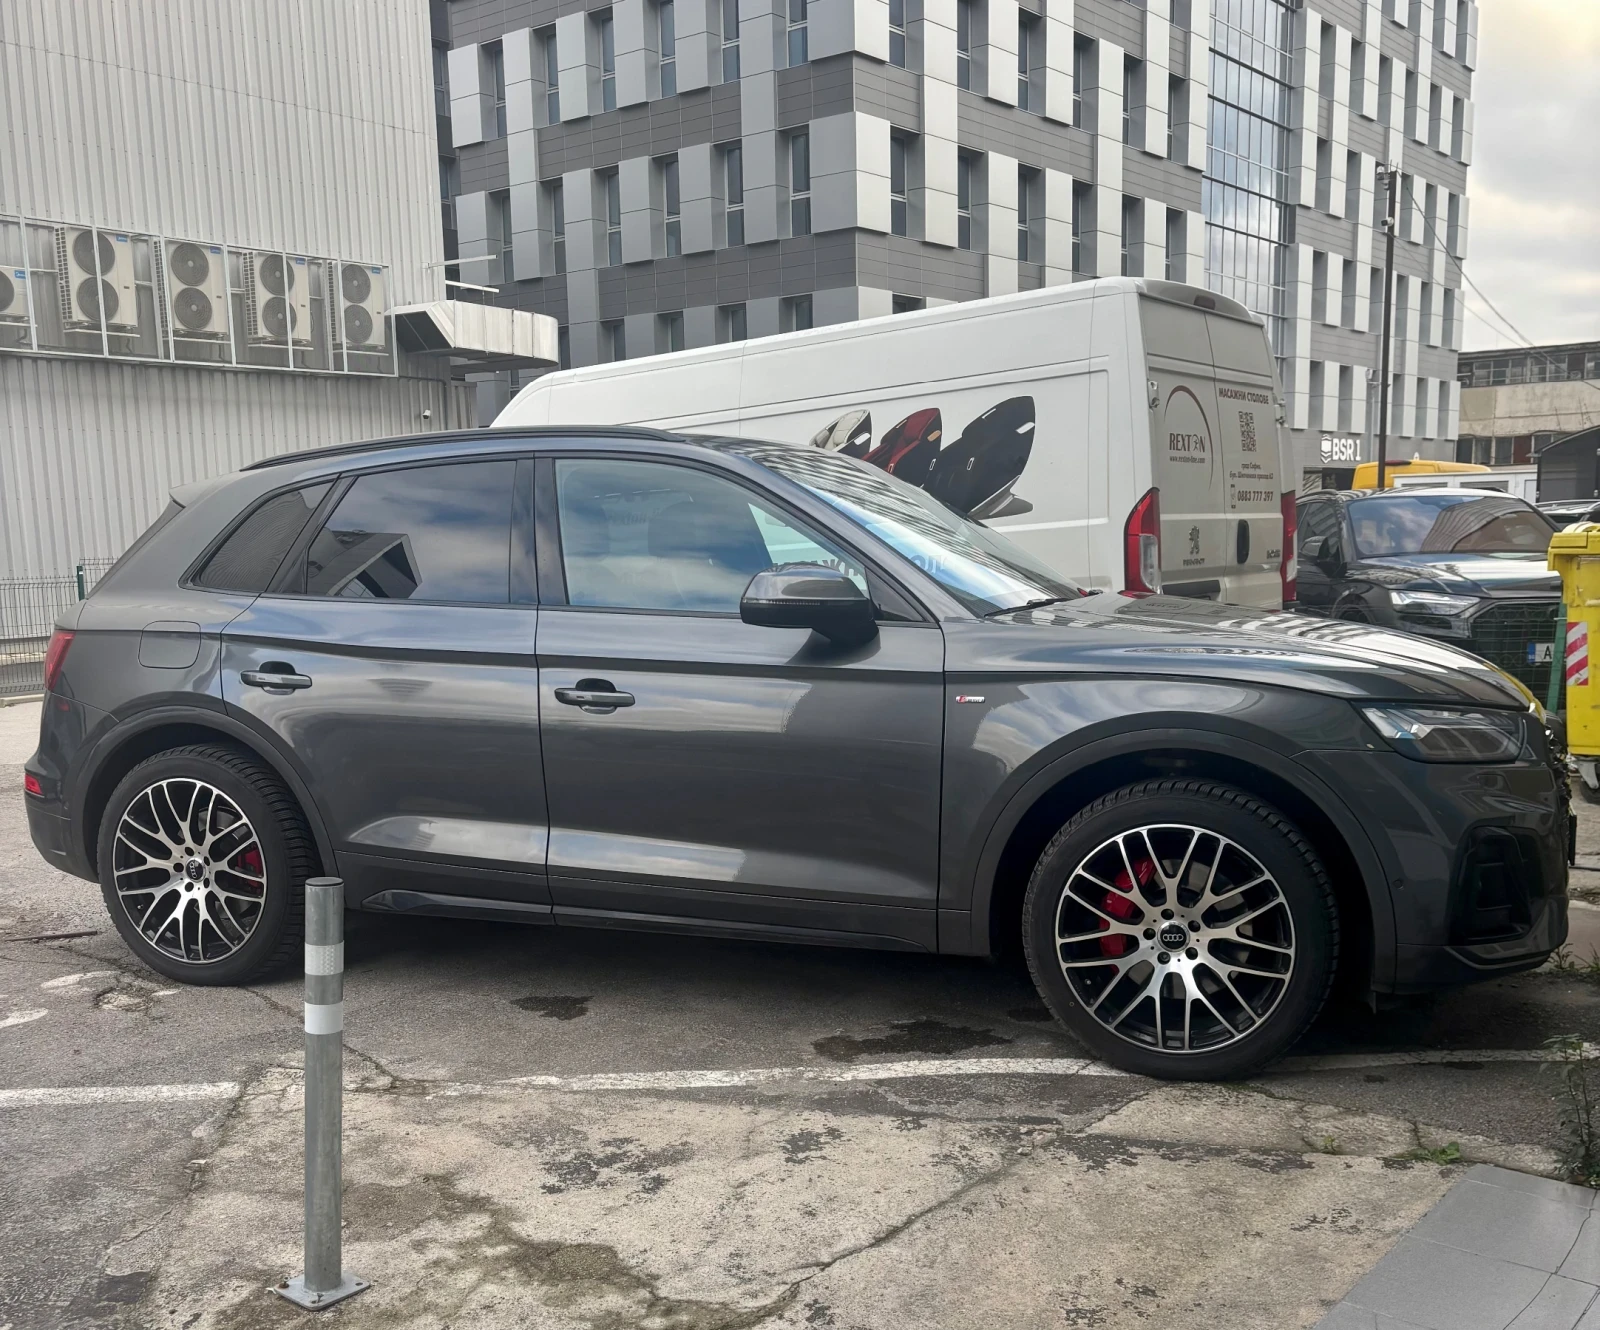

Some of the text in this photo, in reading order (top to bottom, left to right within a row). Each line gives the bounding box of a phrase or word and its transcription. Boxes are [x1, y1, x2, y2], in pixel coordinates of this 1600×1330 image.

[1169, 432, 1206, 453] REXTON
[1332, 438, 1361, 461] BSR 1
[1237, 490, 1274, 502] 0883 777 397
